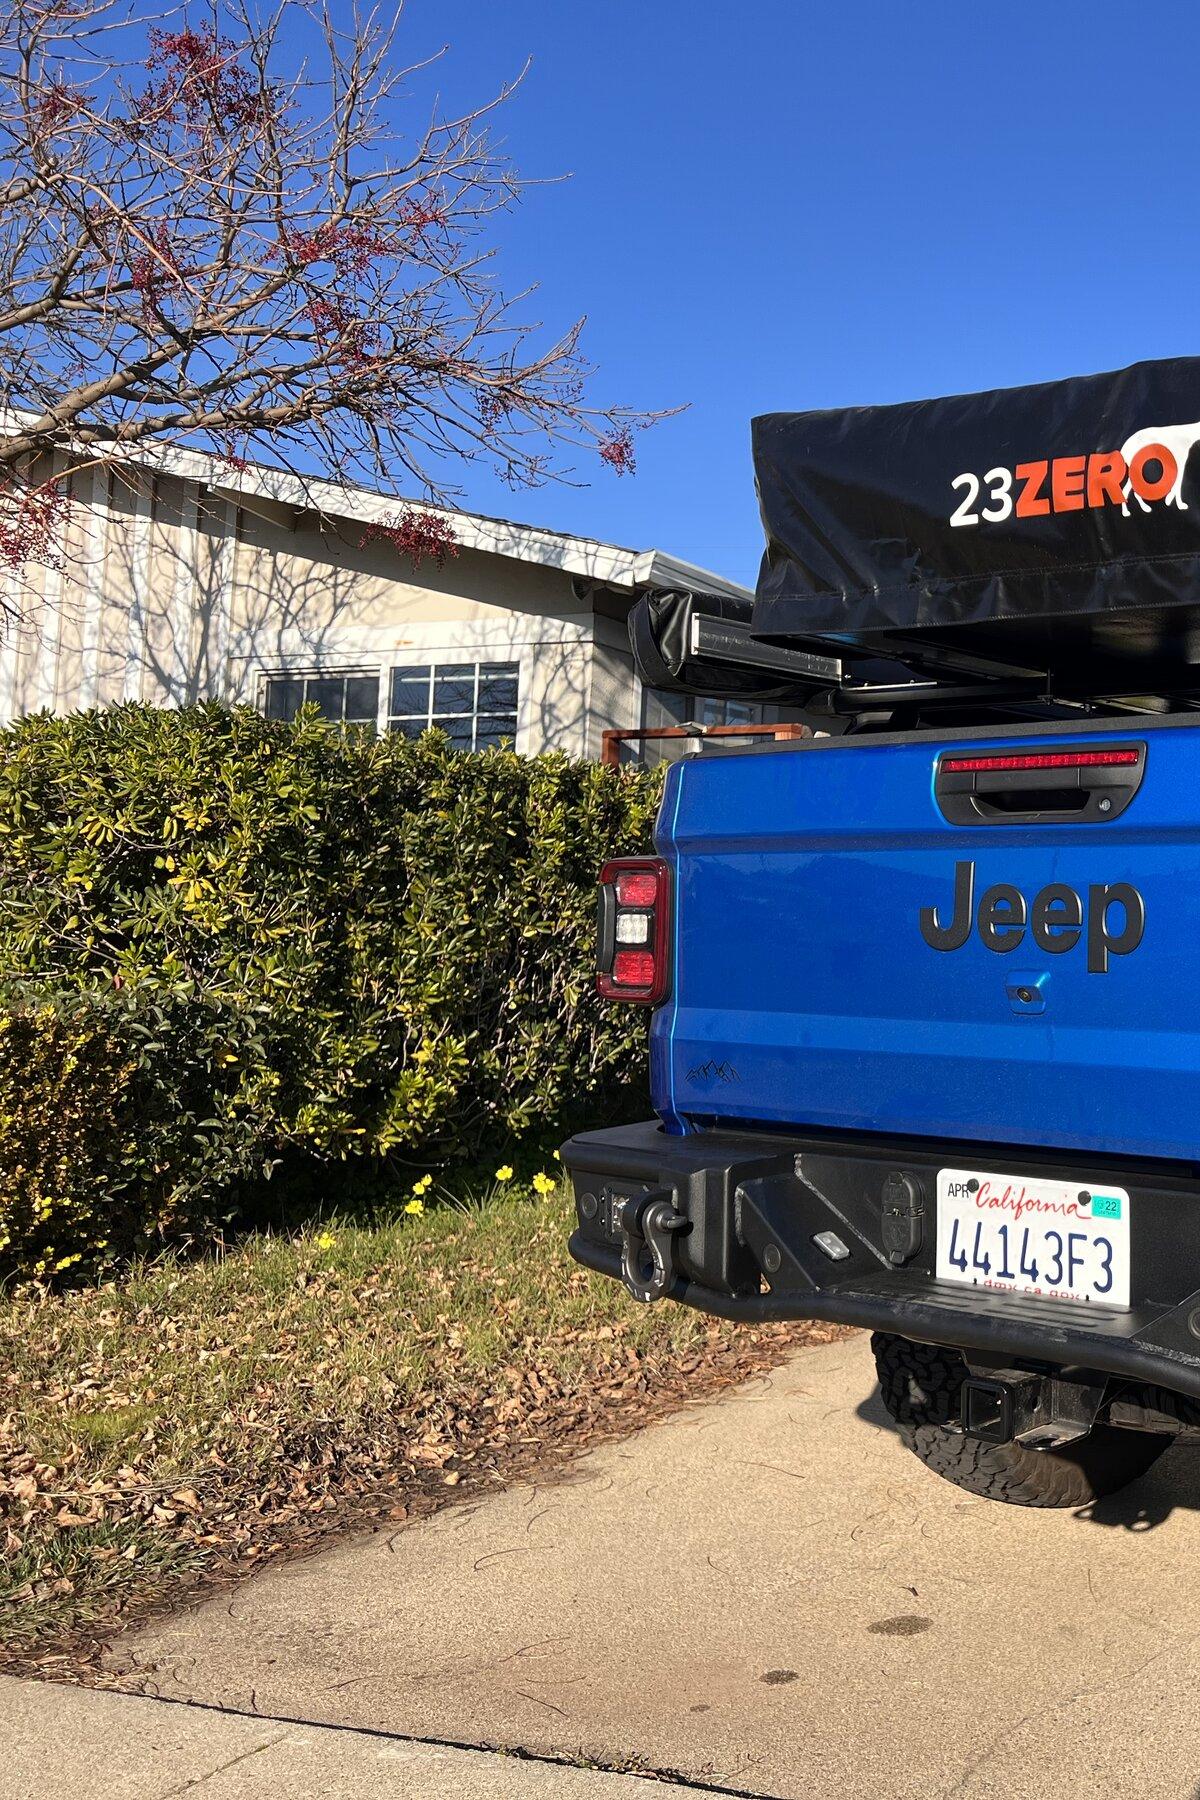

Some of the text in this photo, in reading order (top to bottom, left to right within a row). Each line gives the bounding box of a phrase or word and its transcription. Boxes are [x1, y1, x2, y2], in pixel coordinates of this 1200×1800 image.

[949, 442, 1178, 527] 23ZERO
[919, 861, 1144, 973] Jeep
[948, 1183, 969, 1198] APR
[976, 1182, 1092, 1220] California
[1105, 1200, 1117, 1211] 22
[949, 1218, 1113, 1294] 44143F3
